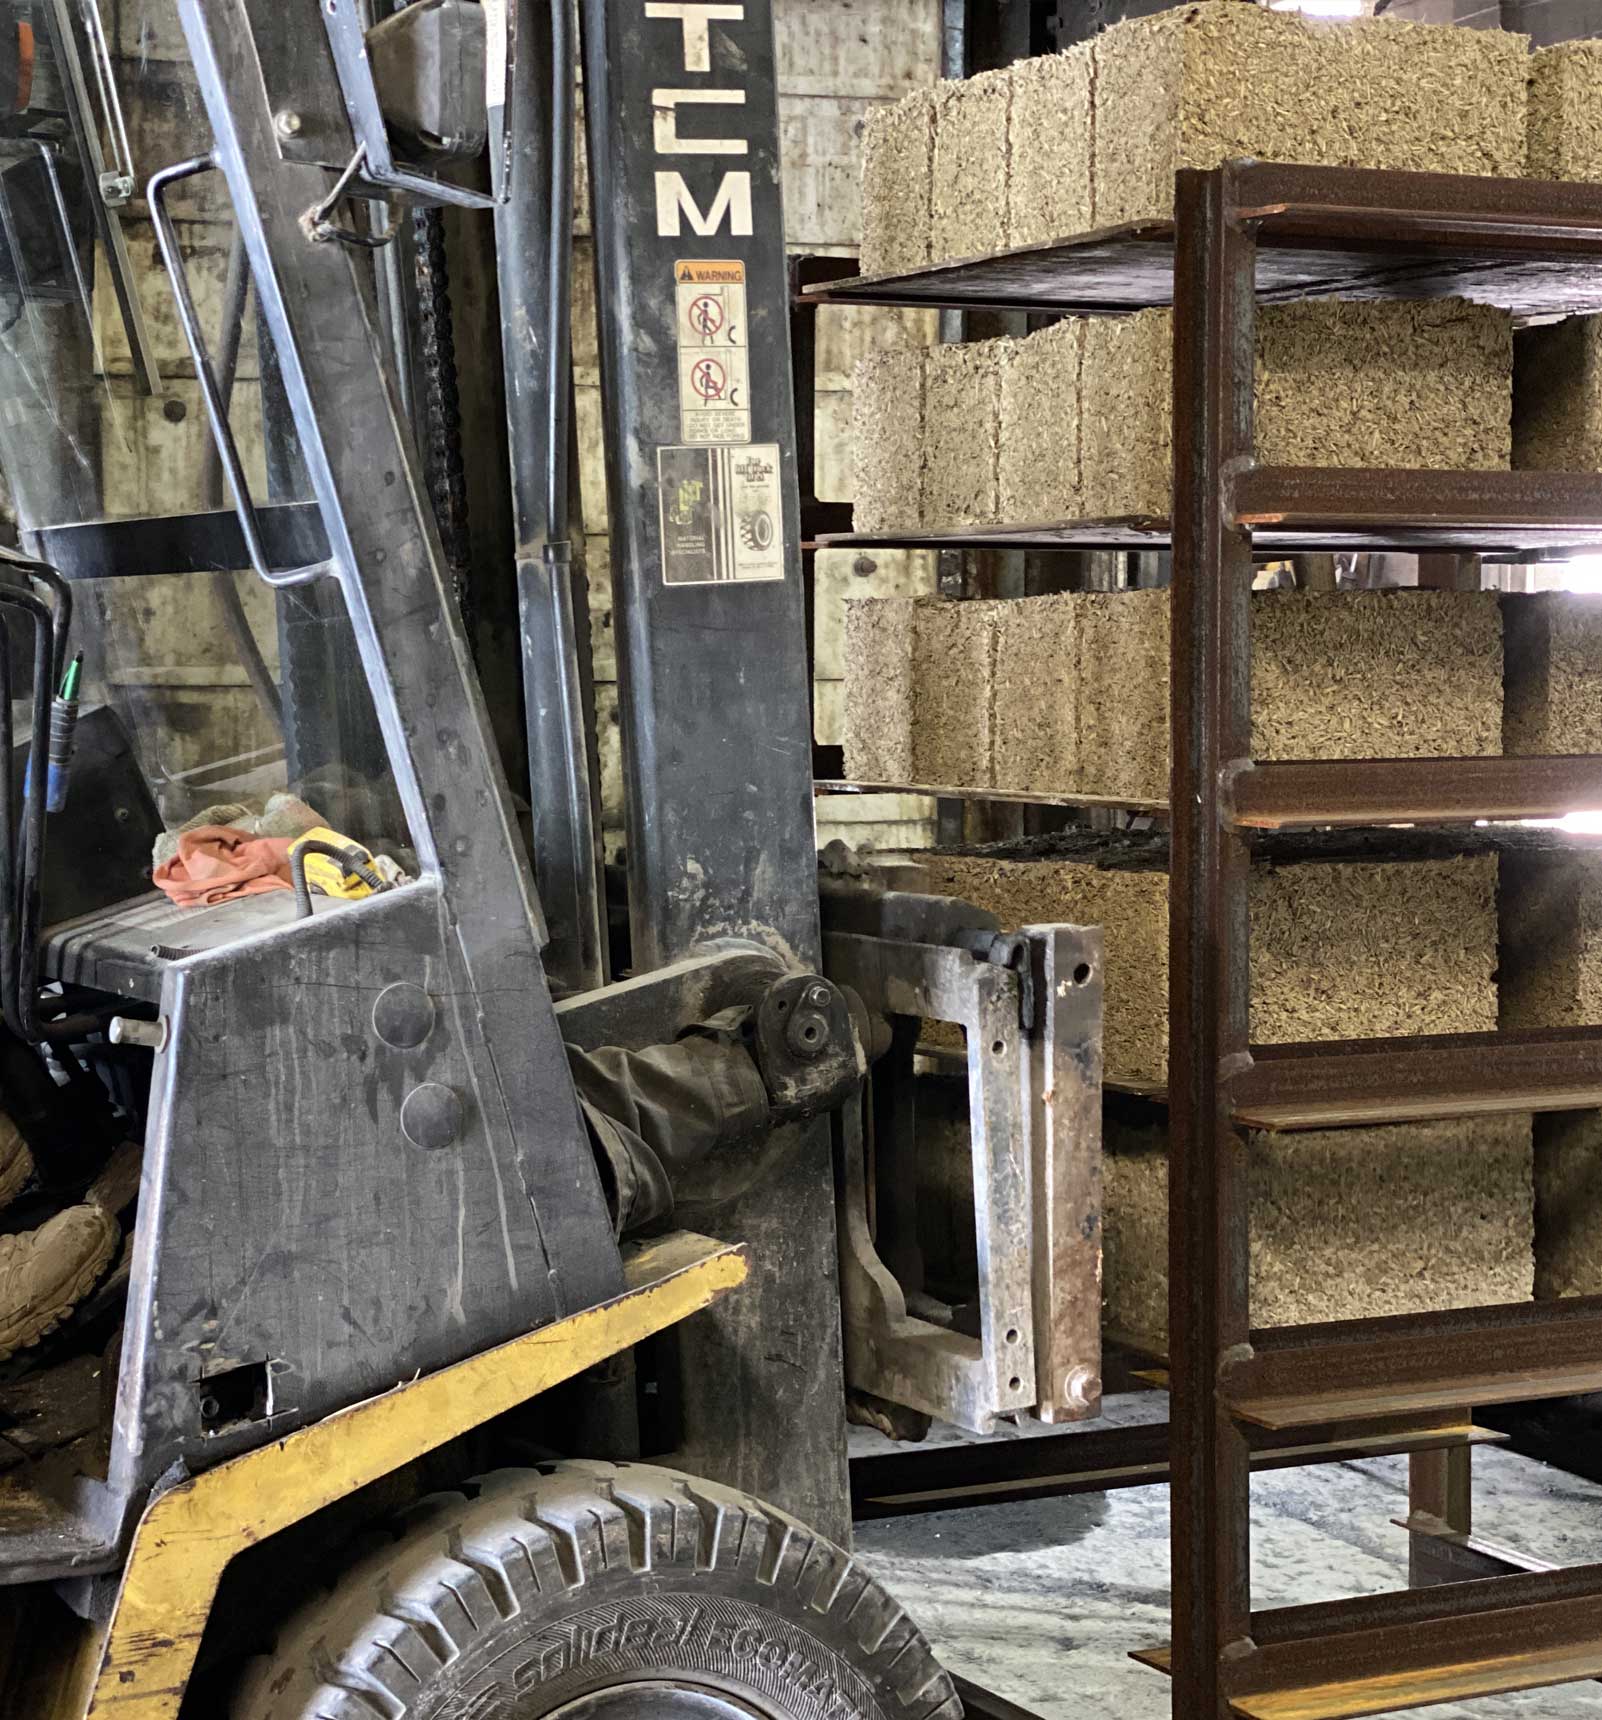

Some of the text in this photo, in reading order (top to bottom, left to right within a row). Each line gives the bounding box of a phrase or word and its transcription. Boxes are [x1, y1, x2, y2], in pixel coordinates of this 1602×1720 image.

[644, 2, 753, 236] TCM
[695, 270, 742, 281] WARNING
[704, 1618, 864, 1720] ECOMAT
